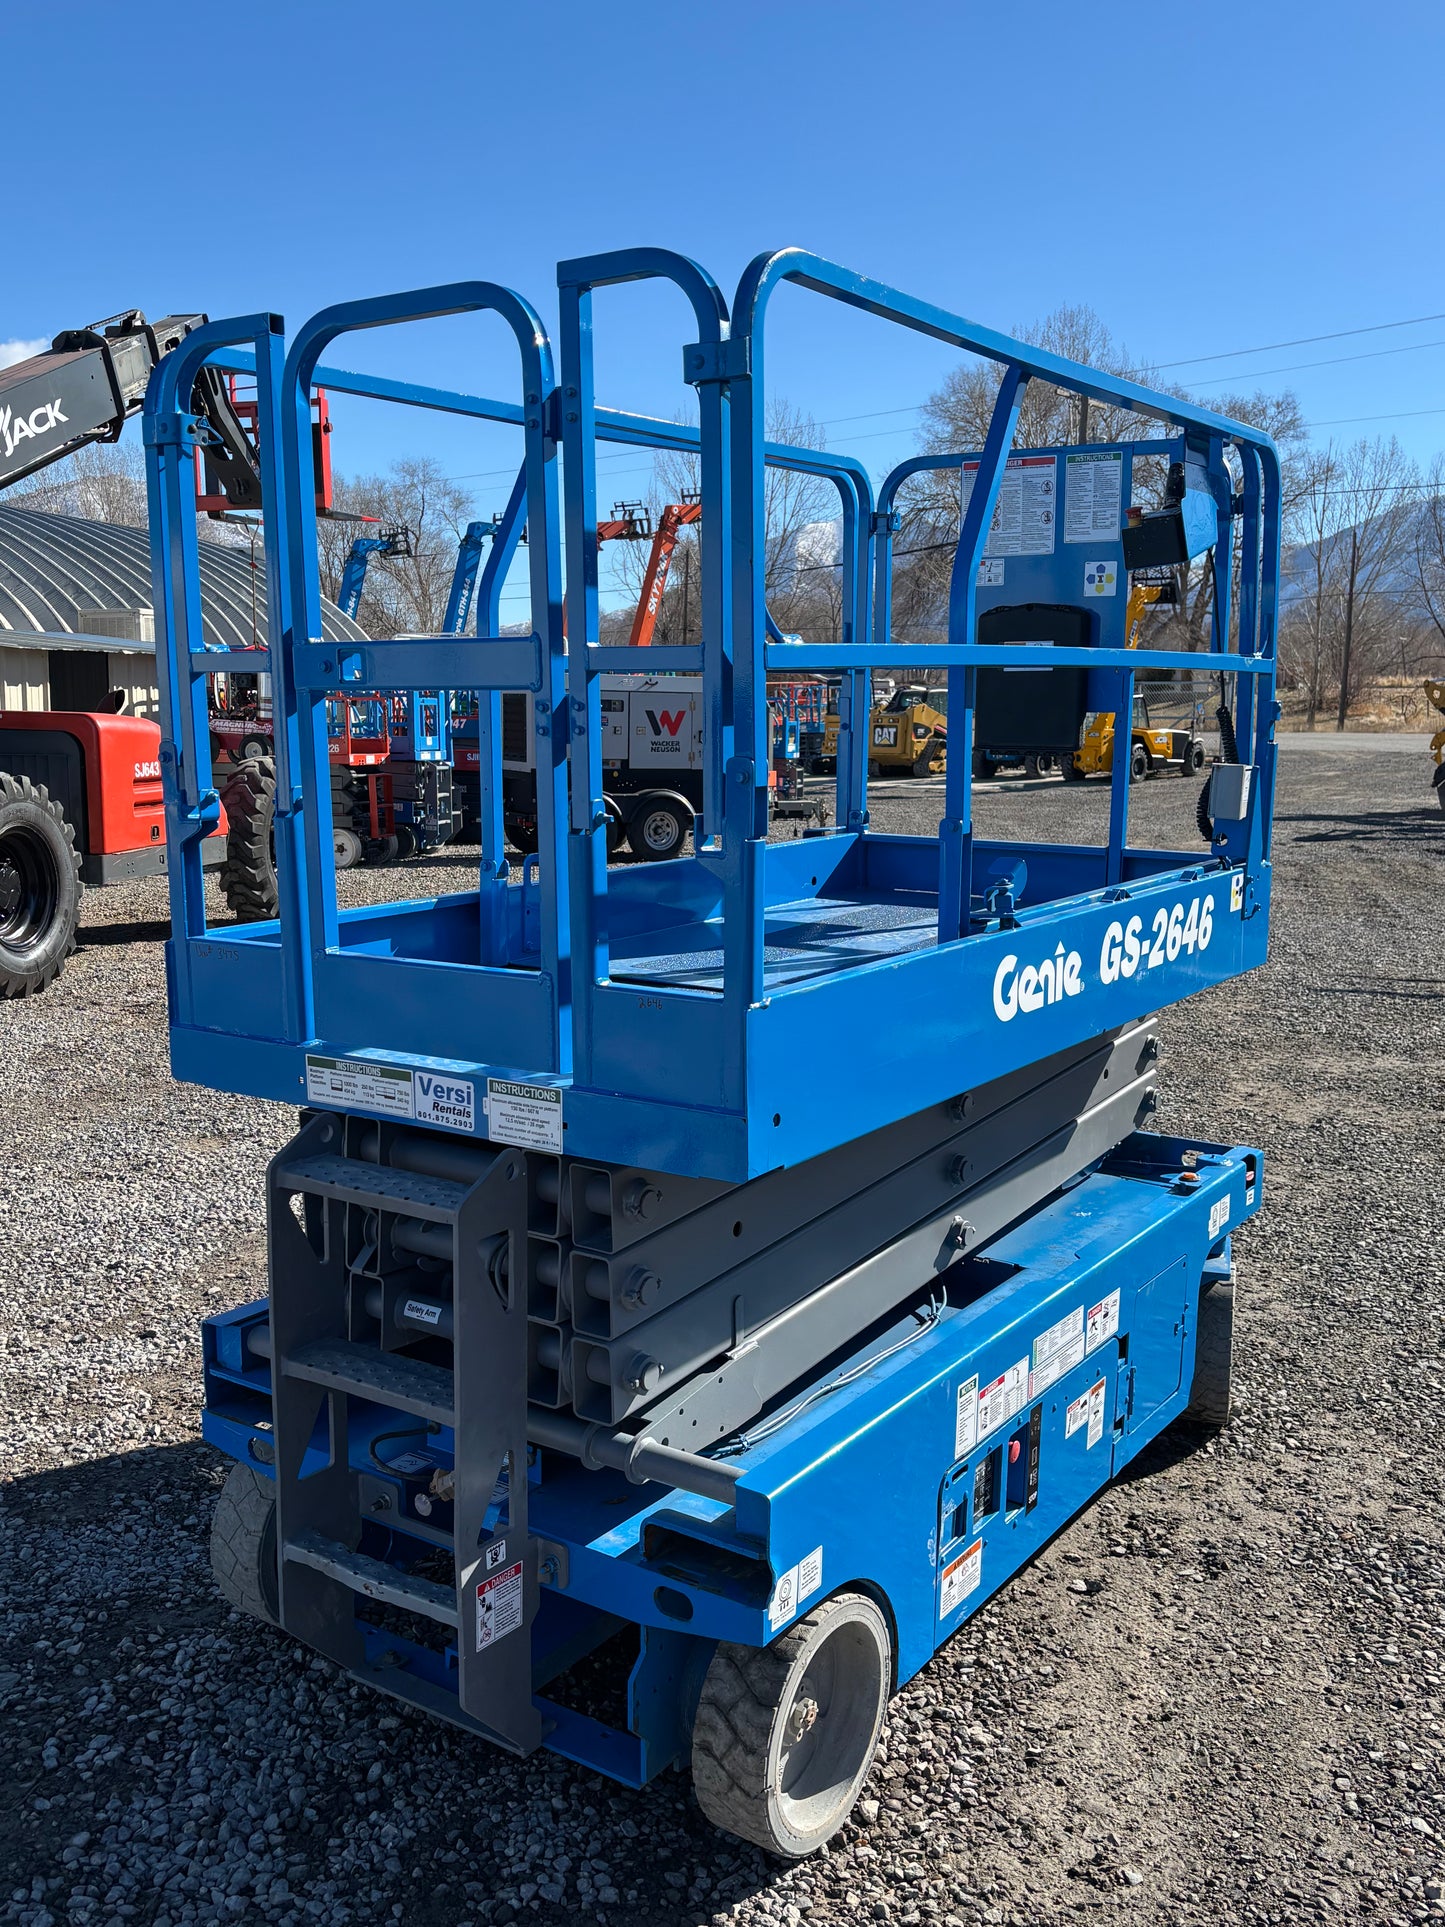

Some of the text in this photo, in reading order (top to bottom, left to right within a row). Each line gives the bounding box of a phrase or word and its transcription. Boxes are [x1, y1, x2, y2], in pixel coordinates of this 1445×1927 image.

[874, 727, 896, 745] CAT
[134, 761, 160, 778] SJ643
[993, 894, 1215, 1022] Genie GS-2646
[335, 1061, 382, 1077] INSTRUCTIONS
[418, 1075, 471, 1105] Versi
[492, 1082, 557, 1102] INSTRUCTIONS
[432, 1101, 471, 1119] Rentals
[417, 1110, 473, 1130] 801.875.2903
[406, 1303, 437, 1318] Safety Arm
[491, 1567, 516, 1588] DANGER
